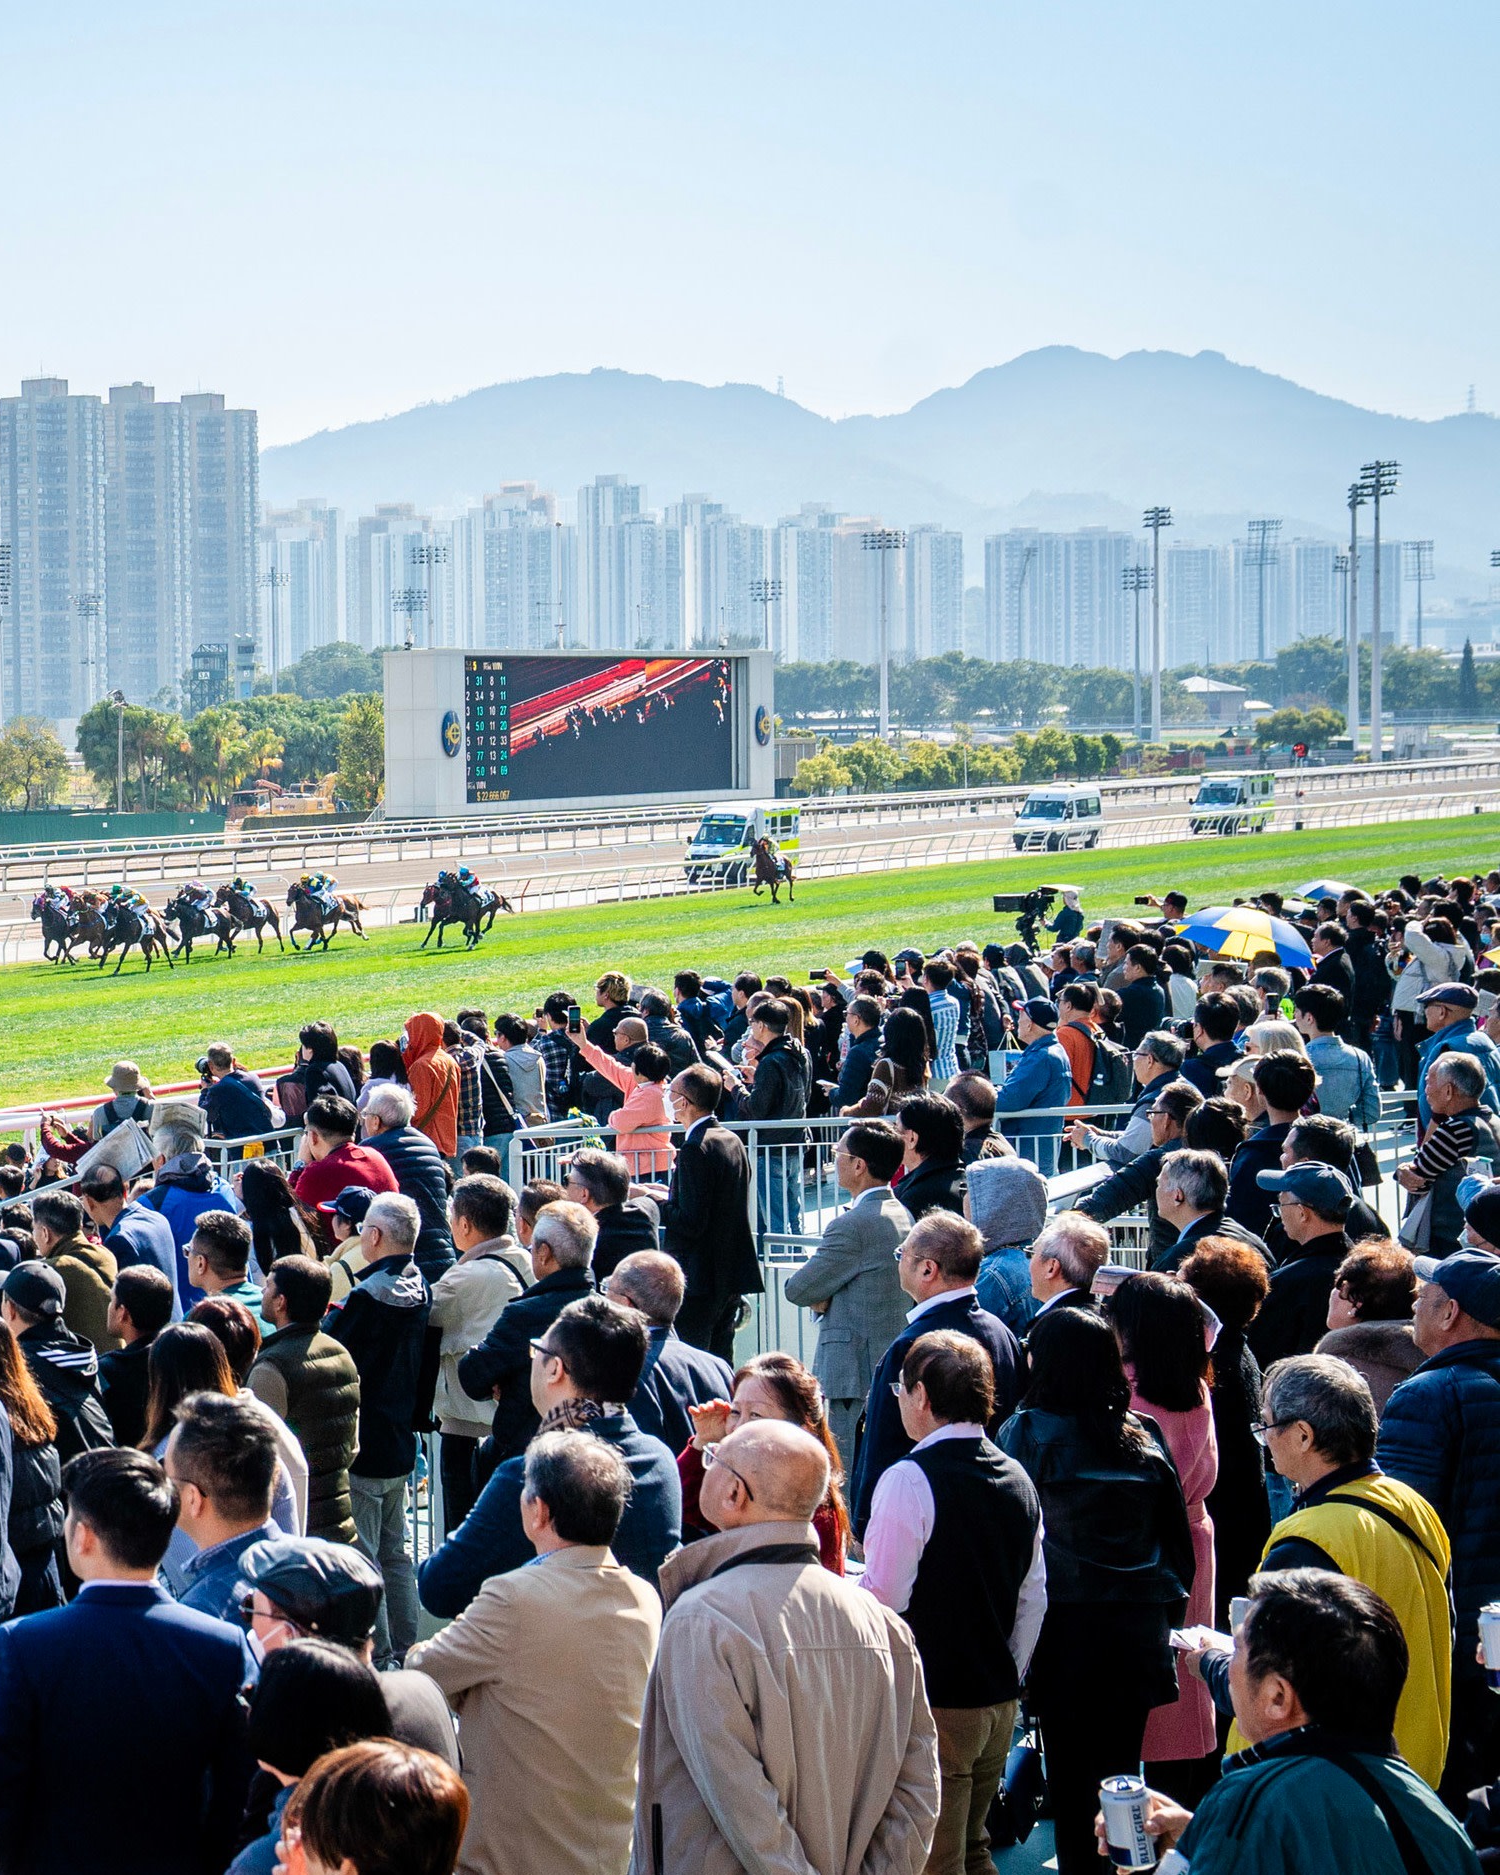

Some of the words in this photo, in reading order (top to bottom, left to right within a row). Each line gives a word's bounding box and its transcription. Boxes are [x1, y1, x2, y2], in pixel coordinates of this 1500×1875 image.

[476, 676, 483, 686] 31
[500, 676, 506, 686] 11
[500, 691, 506, 701] 11
[476, 706, 484, 716] 13
[489, 706, 496, 716] 10
[500, 705, 507, 716] 27
[489, 721, 496, 731] 11
[477, 735, 484, 746] 17
[489, 735, 497, 746] 12
[500, 735, 508, 746] 33
[476, 751, 484, 761] 77
[489, 750, 497, 761] 13
[489, 765, 497, 776] 14
[1132, 1804, 1145, 1834] GIRL
[1137, 1834, 1150, 1865] BLUE
